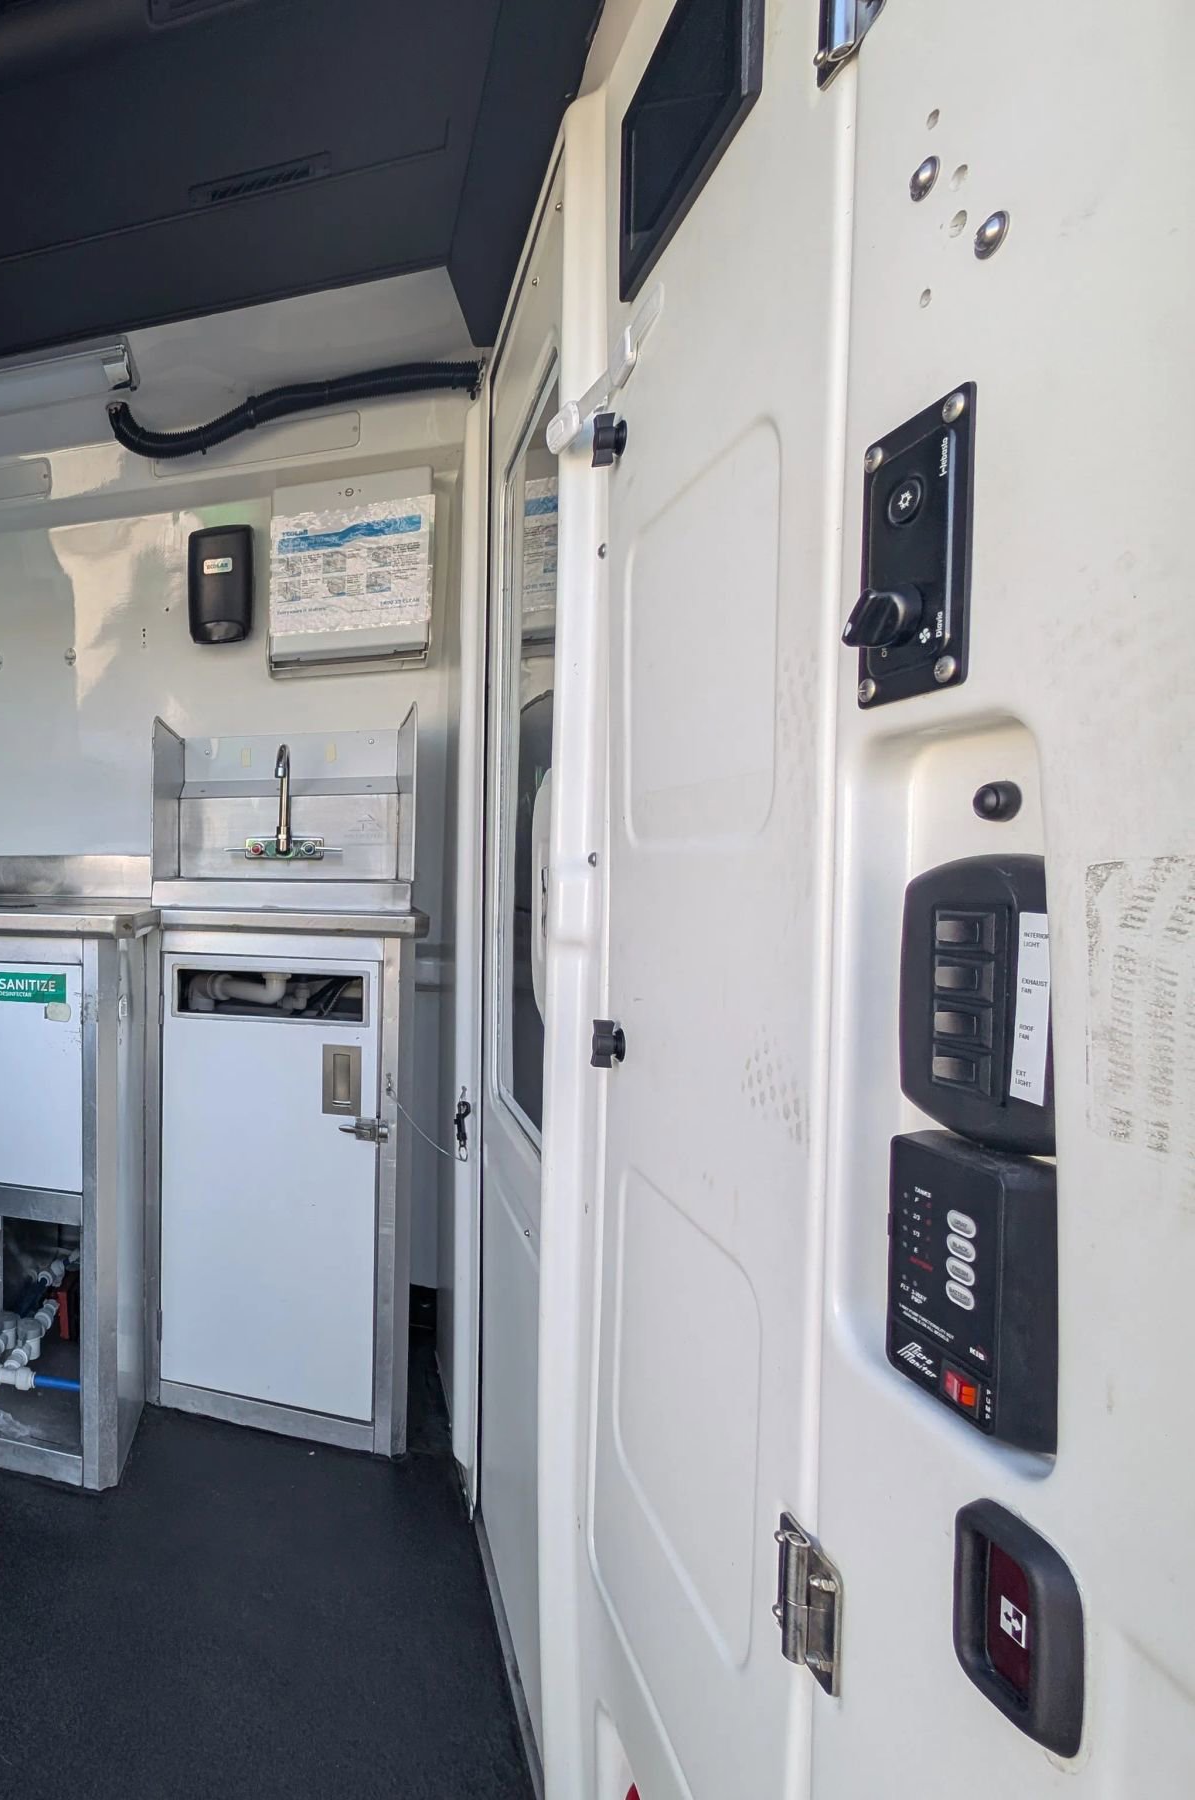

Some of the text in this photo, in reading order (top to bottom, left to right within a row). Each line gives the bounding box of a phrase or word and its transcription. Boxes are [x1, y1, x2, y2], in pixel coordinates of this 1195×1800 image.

[939, 436, 949, 477] Webasto
[935, 611, 943, 638] Diavia
[1021, 977, 1048, 987] EXHAUST
[1021, 987, 1032, 995] FAN
[1019, 1024, 1035, 1032] ROOF
[1018, 1033, 1030, 1041] FAN
[1015, 1069, 1027, 1077] EXT
[1015, 1077, 1032, 1088] LIGHT
[914, 1186, 932, 1199] TANKS
[912, 1213, 921, 1221] 2/3
[912, 1229, 921, 1238] 1/3
[952, 1241, 969, 1253] BLACK
[948, 1286, 970, 1302] BATTERY
[898, 1342, 934, 1365] Micro
[969, 1346, 985, 1361] KIB
[900, 1350, 937, 1378] Monitor
